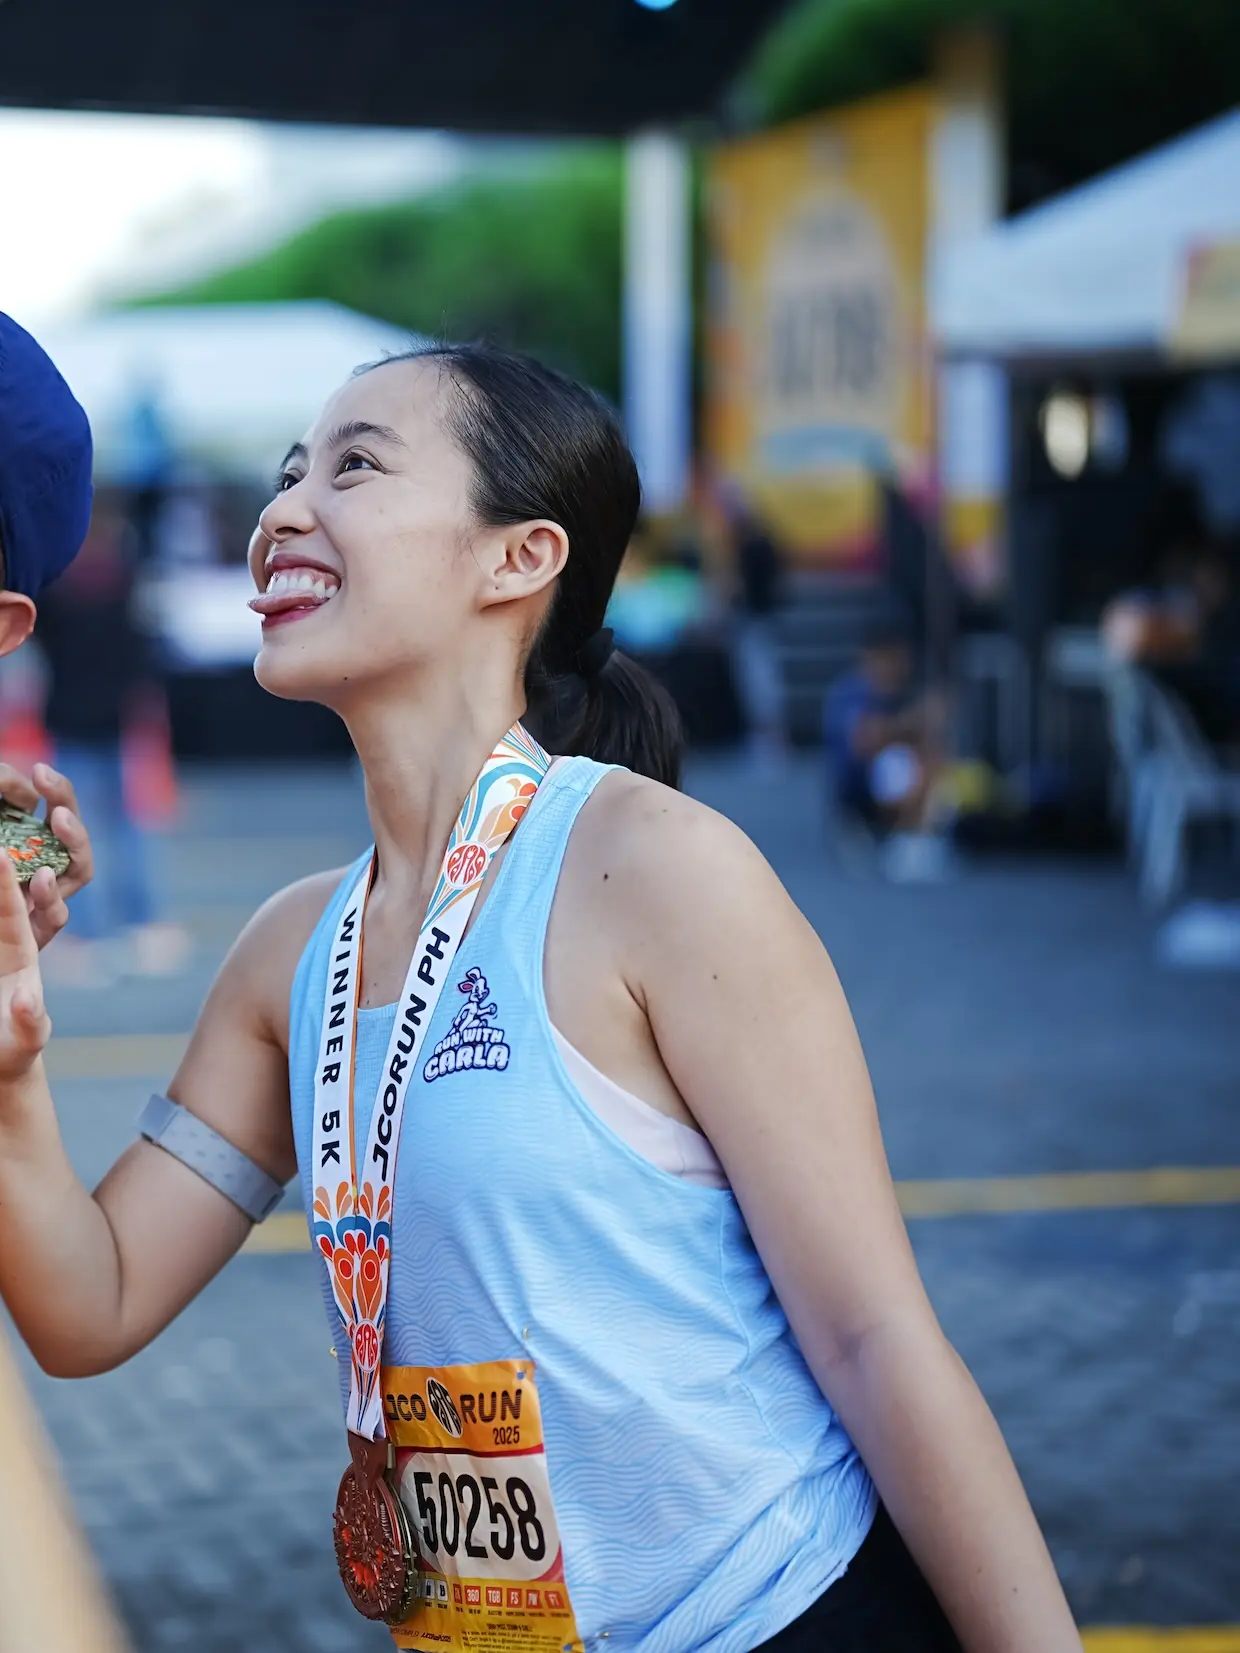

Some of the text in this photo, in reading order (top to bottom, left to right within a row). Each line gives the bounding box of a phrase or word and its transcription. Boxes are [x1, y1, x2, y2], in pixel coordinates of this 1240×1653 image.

[321, 907, 357, 1167] WINNER 5K
[372, 926, 450, 1182] JCORUN PH
[433, 1027, 505, 1056] RUN WITH
[423, 1042, 511, 1083] CARLA
[386, 1389, 523, 1424] JCO RUN
[493, 1425, 521, 1445] 2025
[413, 1472, 546, 1562] 50258
